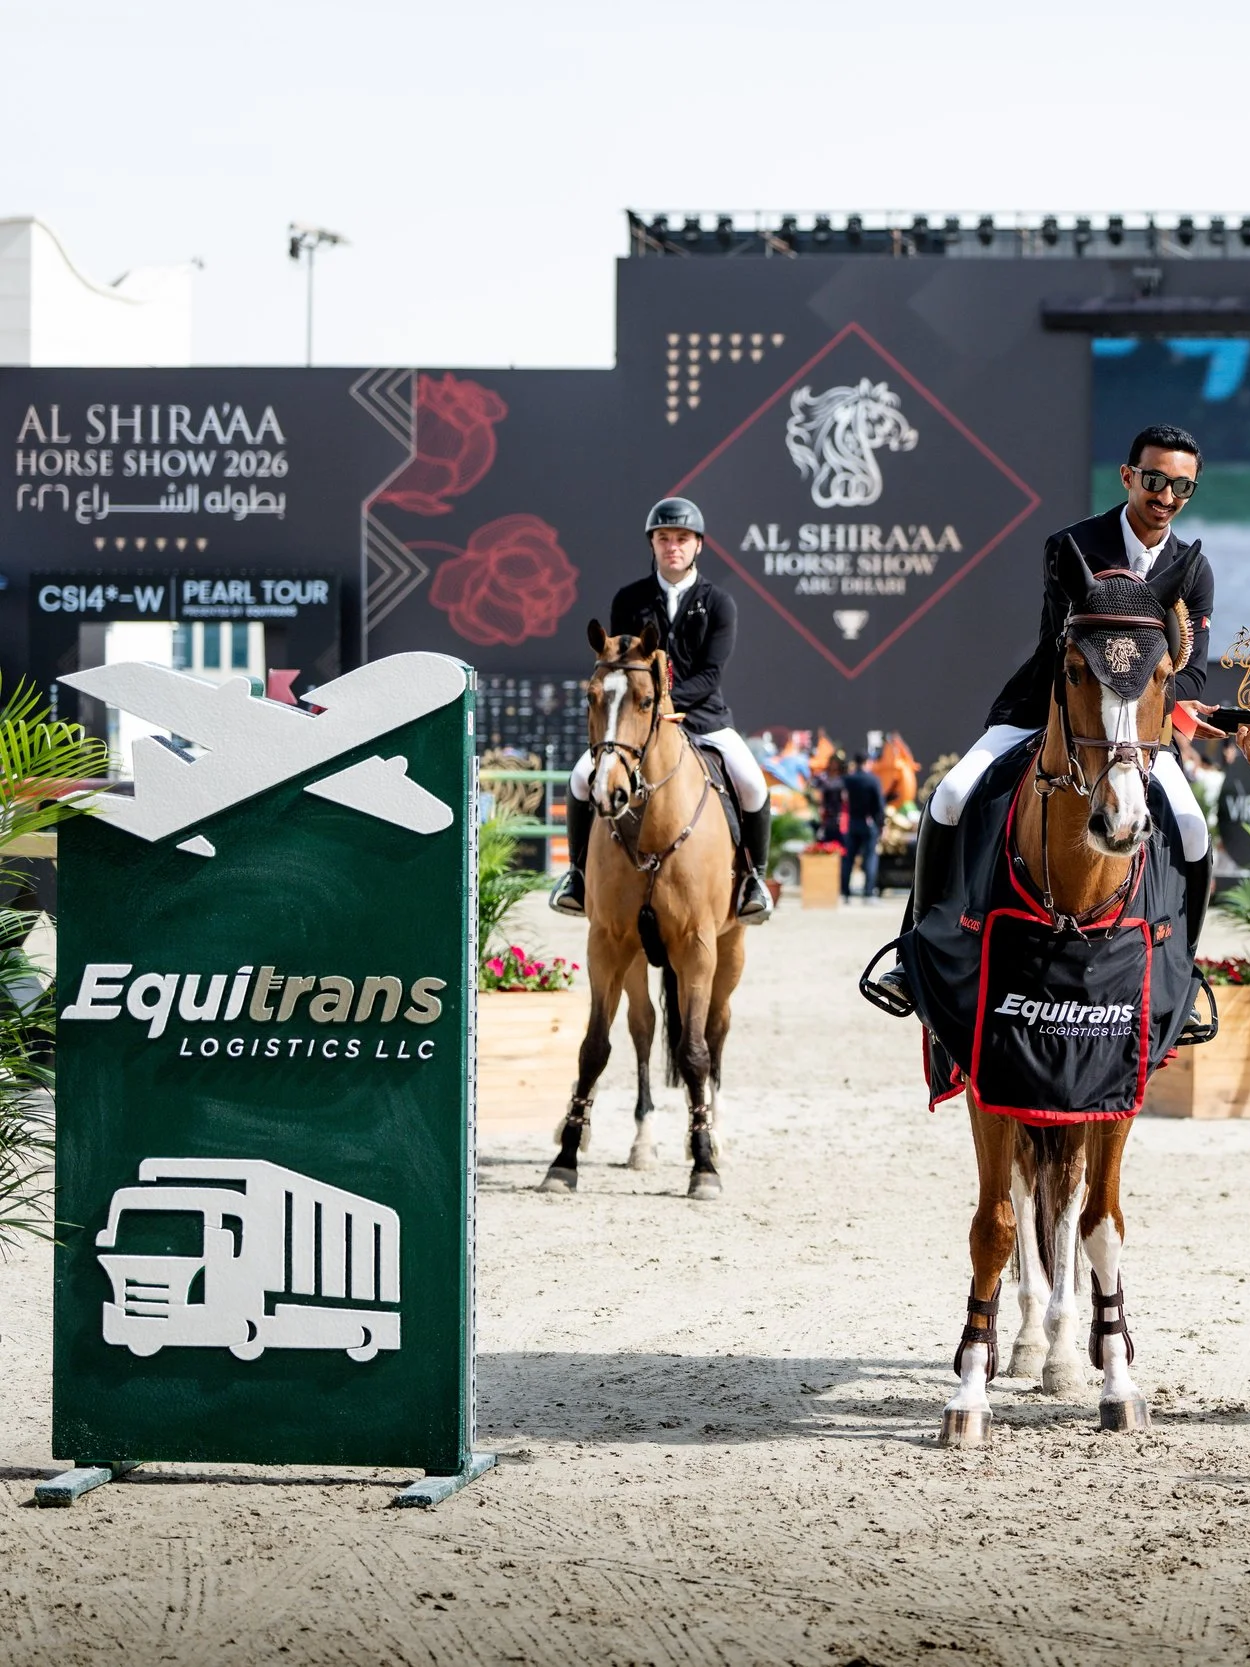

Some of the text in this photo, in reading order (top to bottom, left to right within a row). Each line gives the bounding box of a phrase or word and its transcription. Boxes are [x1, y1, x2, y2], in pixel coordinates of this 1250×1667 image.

[16, 402, 287, 444] AL SHIRA'AA
[16, 449, 289, 477] HORSE SHOW 2026
[740, 523, 963, 552] AL SHIRA'AA
[764, 552, 938, 576] HORSE SHOW
[182, 580, 329, 604] PEARL TOUR
[60, 963, 447, 1039] Equitrans
[994, 993, 1135, 1025] Equitrans
[1039, 1025, 1132, 1037] LOGISTICS LLC
[179, 1037, 435, 1059] LOGISTICS LLC
